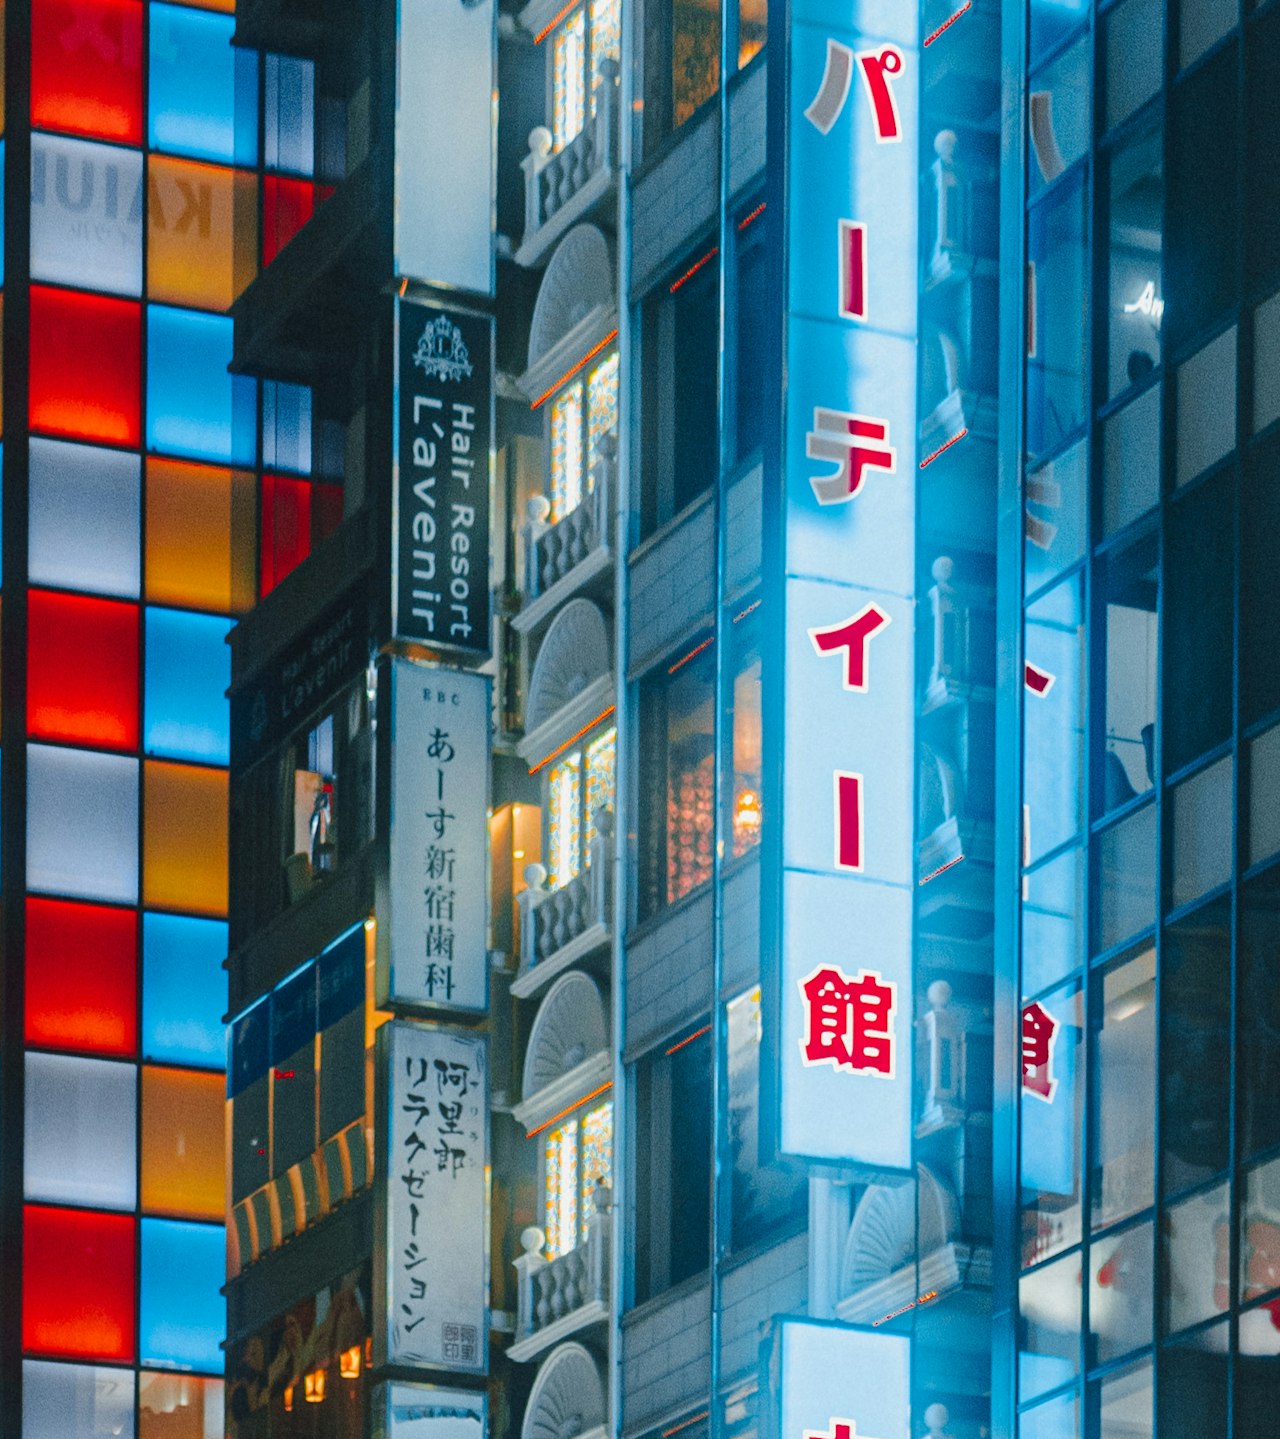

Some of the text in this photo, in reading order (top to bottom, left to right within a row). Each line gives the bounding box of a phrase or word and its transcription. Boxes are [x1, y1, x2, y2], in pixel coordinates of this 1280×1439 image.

[411, 395, 448, 634] L'avenir
[449, 402, 476, 640] Hair Resort
[796, 36, 909, 1080] パーティー館
[424, 725, 457, 1001] あーす新宿歯科
[401, 1056, 430, 1334] リラクゼーション
[433, 1059, 471, 1180] 阿里郎
